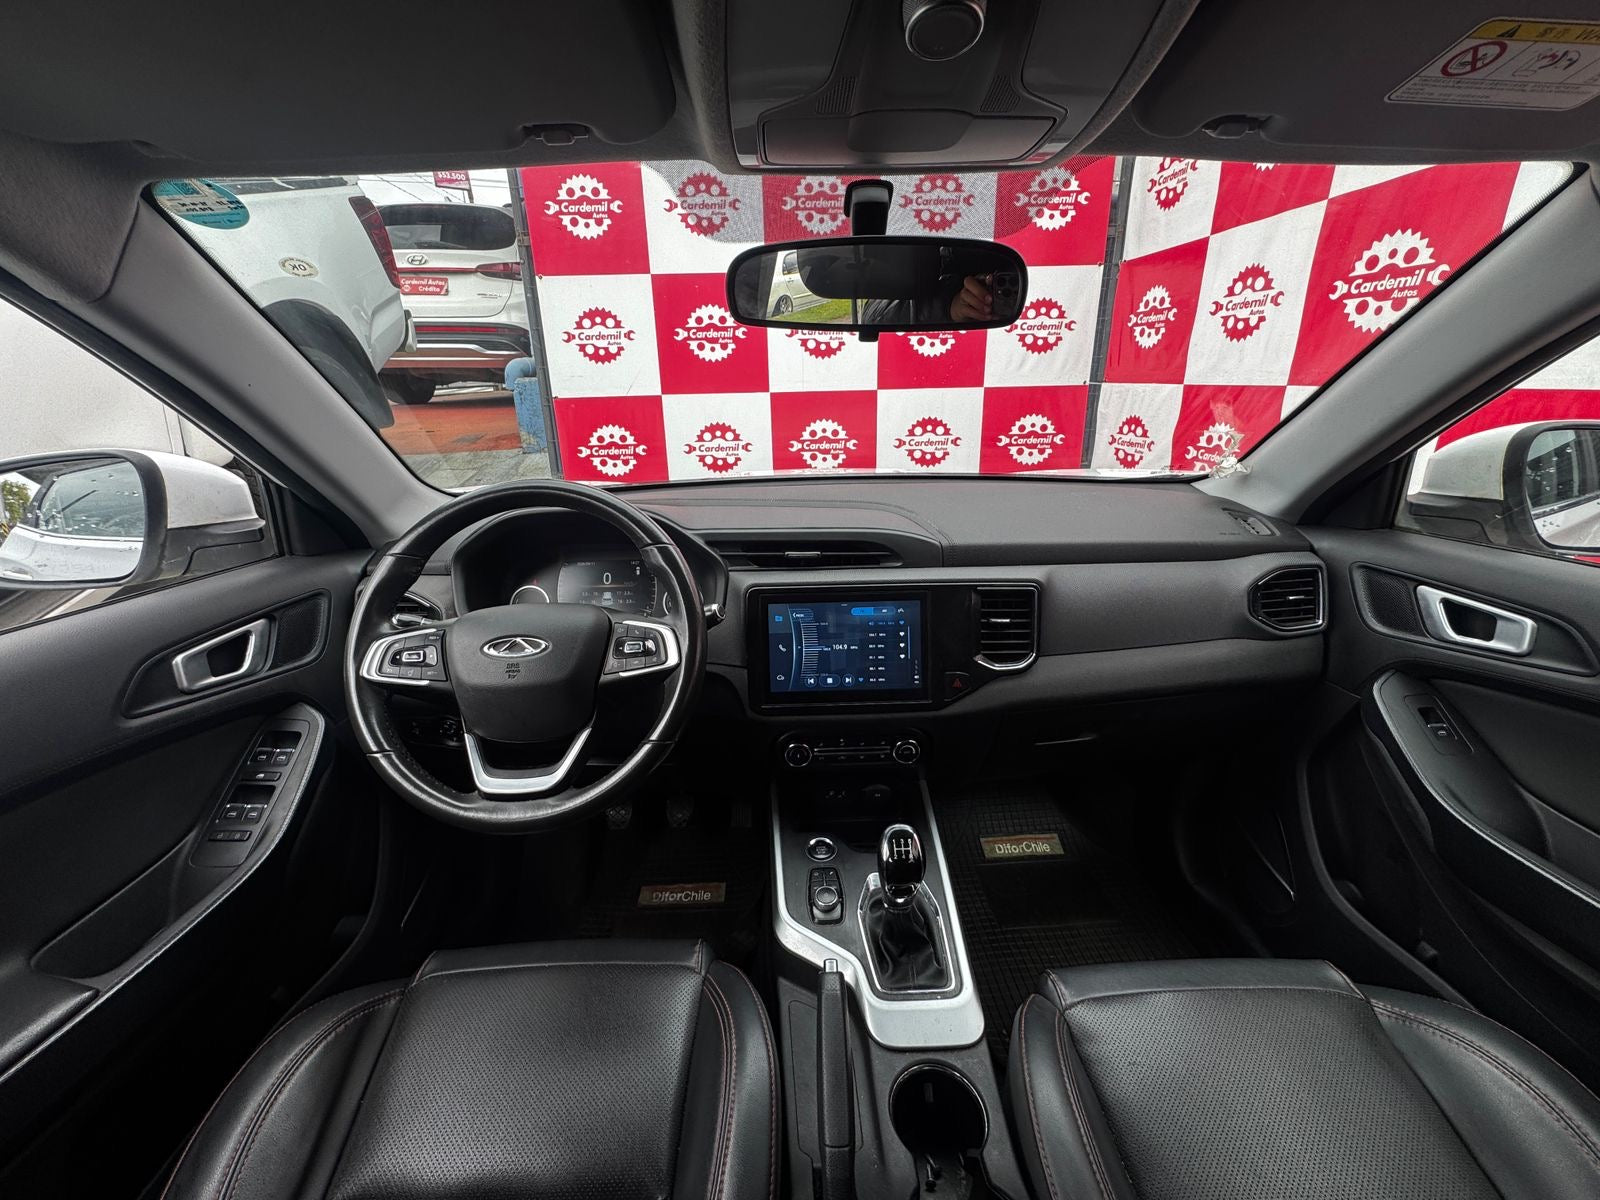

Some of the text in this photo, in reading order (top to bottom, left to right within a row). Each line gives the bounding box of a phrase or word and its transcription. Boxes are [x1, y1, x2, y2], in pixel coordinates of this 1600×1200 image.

[1157, 161, 1189, 186] Cardemil
[680, 199, 727, 210] Cardemil
[798, 196, 844, 208] Cardemil
[915, 194, 961, 206] Cardemil
[1029, 193, 1077, 204] Cardemil
[561, 201, 608, 213] Cardemil
[428, 278, 445, 286] Autos
[1350, 268, 1426, 295] Cardemil
[1391, 289, 1418, 299] Autos
[1225, 294, 1269, 312] Cardemil
[1137, 308, 1168, 324] Cardemil
[1020, 320, 1064, 332] Cardemil
[577, 331, 621, 341] Cardemil
[689, 328, 733, 339] Cardemil
[803, 440, 845, 450] Cardemil
[908, 437, 949, 447] Cardemil
[1011, 434, 1053, 445] Cardemil
[1117, 438, 1147, 450] Cardemil
[592, 445, 634, 456] Cardemil
[698, 443, 740, 453] Cardemil
[603, 572, 612, 585] 0
[995, 841, 1050, 854] DiforChile
[652, 890, 712, 902] DiforChile
